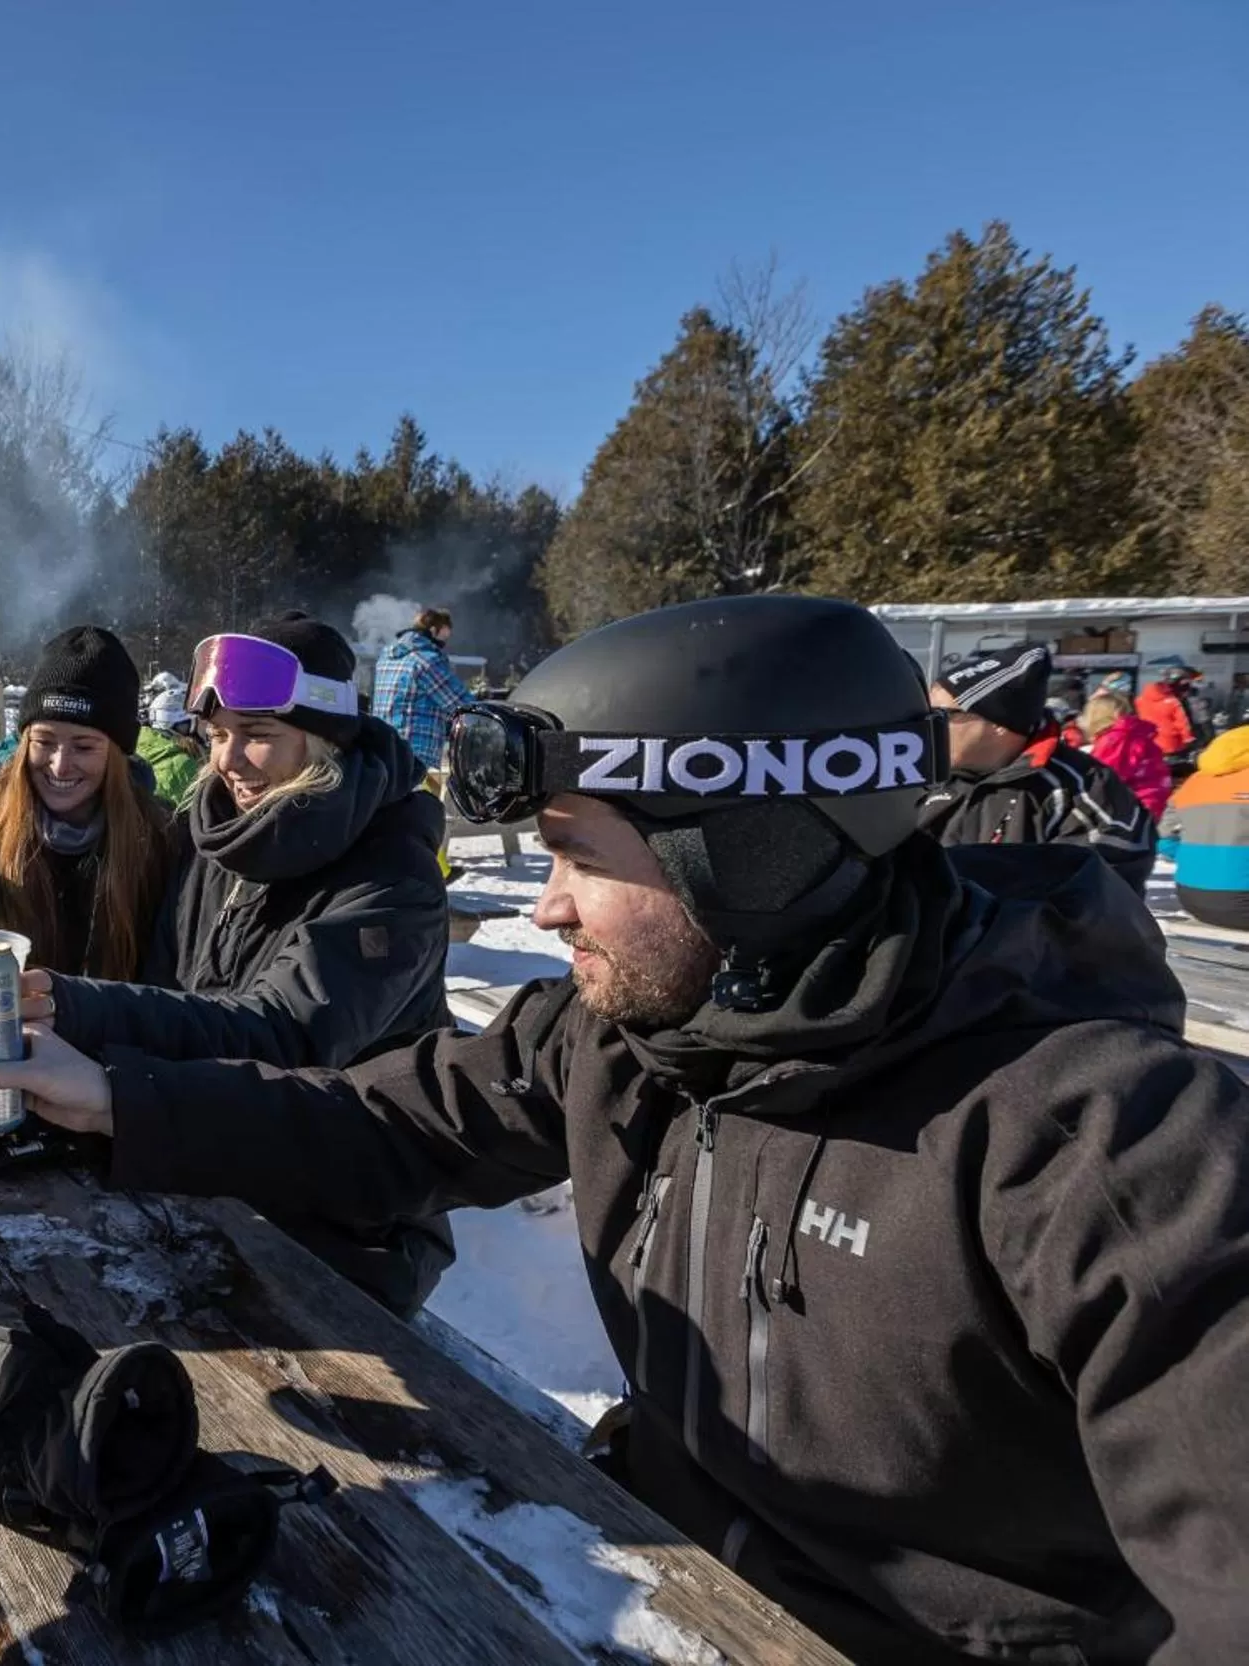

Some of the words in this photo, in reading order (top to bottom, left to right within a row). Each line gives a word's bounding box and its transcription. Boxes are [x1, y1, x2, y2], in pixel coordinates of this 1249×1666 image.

[948, 659, 1001, 685] PING
[578, 731, 926, 796] ZIONOR
[799, 1199, 870, 1257] HH
